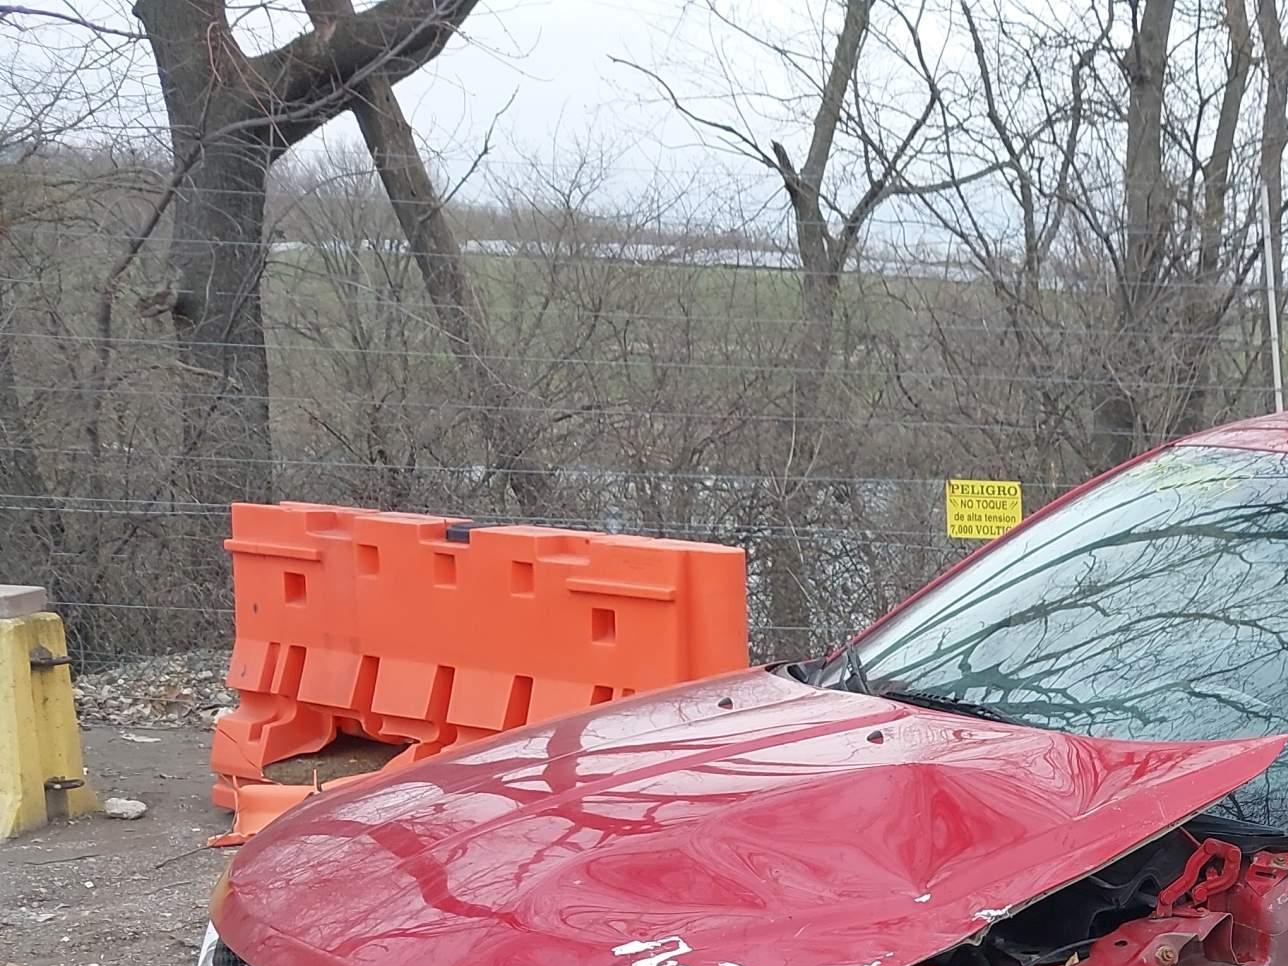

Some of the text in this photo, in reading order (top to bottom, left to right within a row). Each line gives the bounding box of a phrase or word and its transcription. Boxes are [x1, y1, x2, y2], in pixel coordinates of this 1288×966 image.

[951, 484, 1018, 497] PELIGRO
[960, 498, 1008, 510] NO TOQUE
[954, 512, 1016, 523] de alta tension
[950, 524, 974, 536] 7,000
